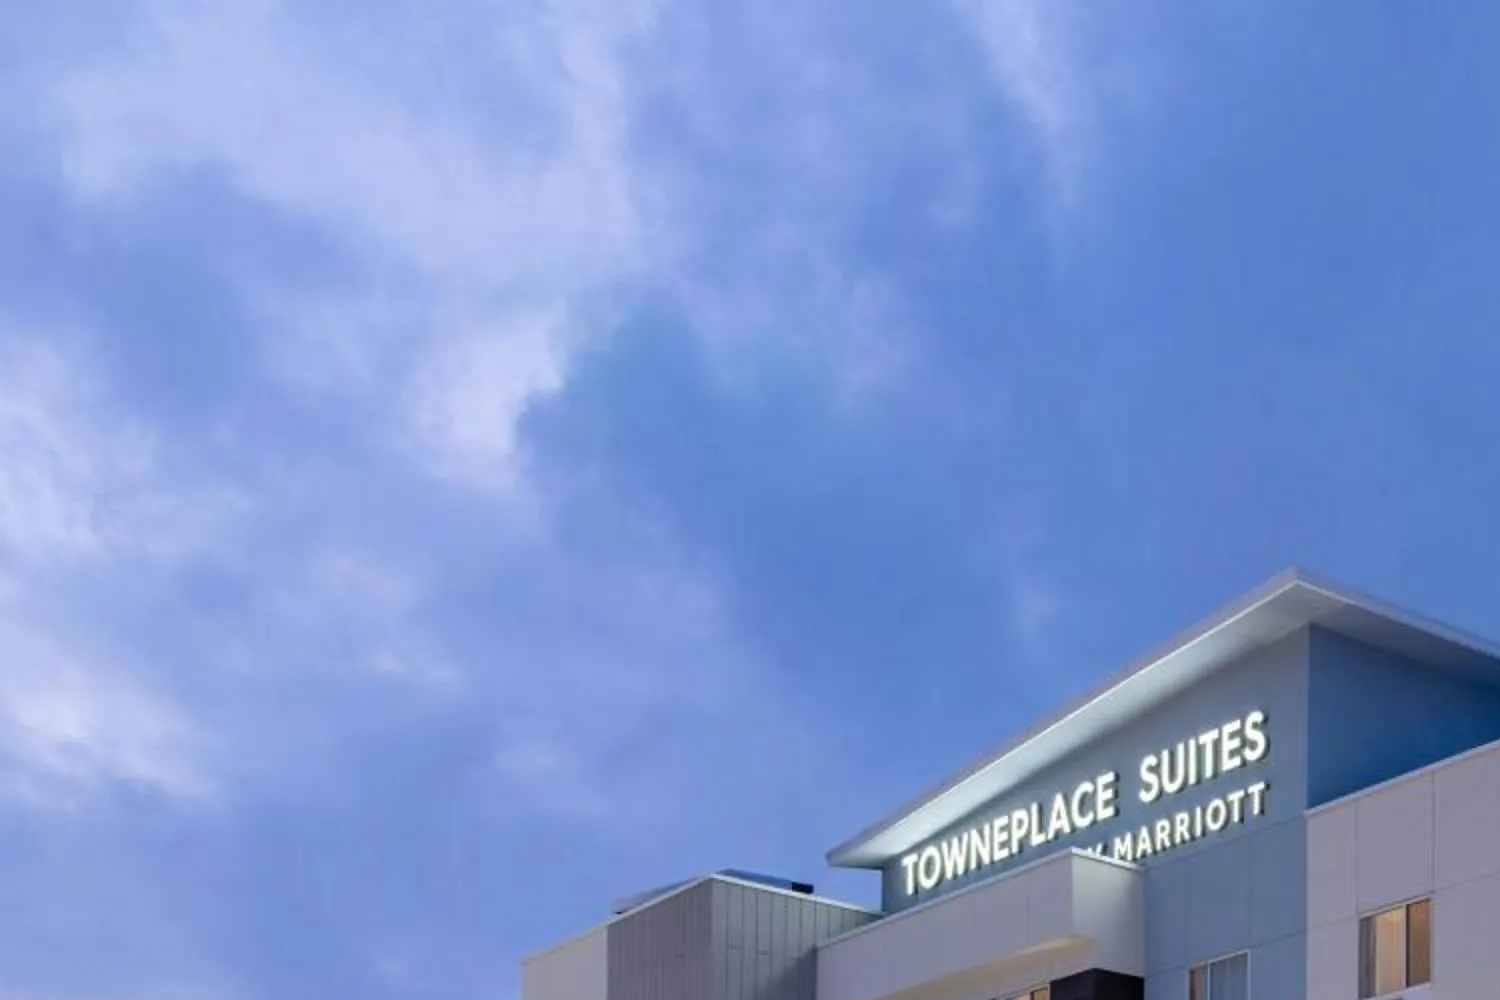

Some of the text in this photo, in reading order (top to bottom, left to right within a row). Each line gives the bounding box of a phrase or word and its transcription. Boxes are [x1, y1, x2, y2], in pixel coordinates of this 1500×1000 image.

[902, 709, 1266, 896] TOWNEPLACE SUITES
[1113, 781, 1266, 861] MARRIOTT
